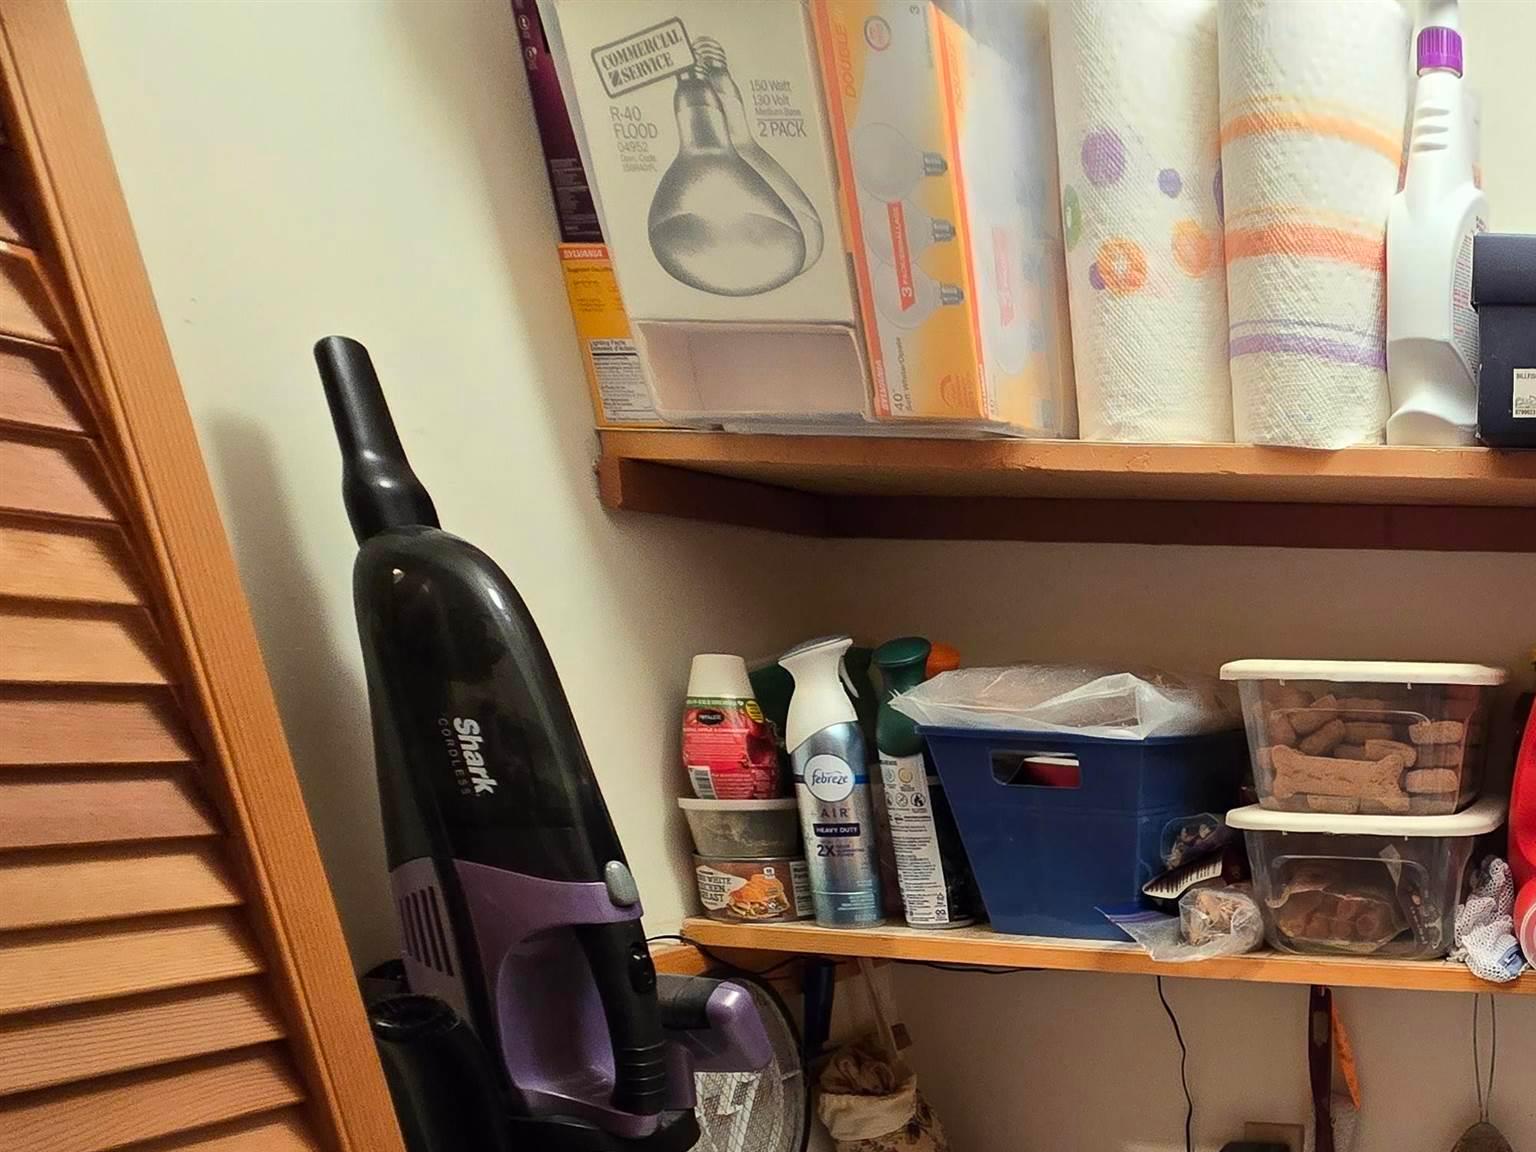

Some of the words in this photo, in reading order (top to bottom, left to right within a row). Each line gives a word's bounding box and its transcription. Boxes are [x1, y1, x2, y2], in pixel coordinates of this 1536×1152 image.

[600, 28, 682, 71] COMMERCIAL
[620, 52, 674, 84] SERVICE
[750, 80, 769, 92] 150
[770, 80, 792, 92] Watt
[752, 94, 770, 106] 130
[772, 94, 790, 106] Volt
[614, 123, 658, 140] FLOOD
[758, 121, 768, 138] 2
[770, 121, 808, 138] PACK
[438, 718, 472, 795] CORDLESS
[452, 717, 498, 794] Shark
[812, 768, 849, 786] febreze
[820, 808, 848, 818] AIR
[816, 844, 836, 857] 2X
